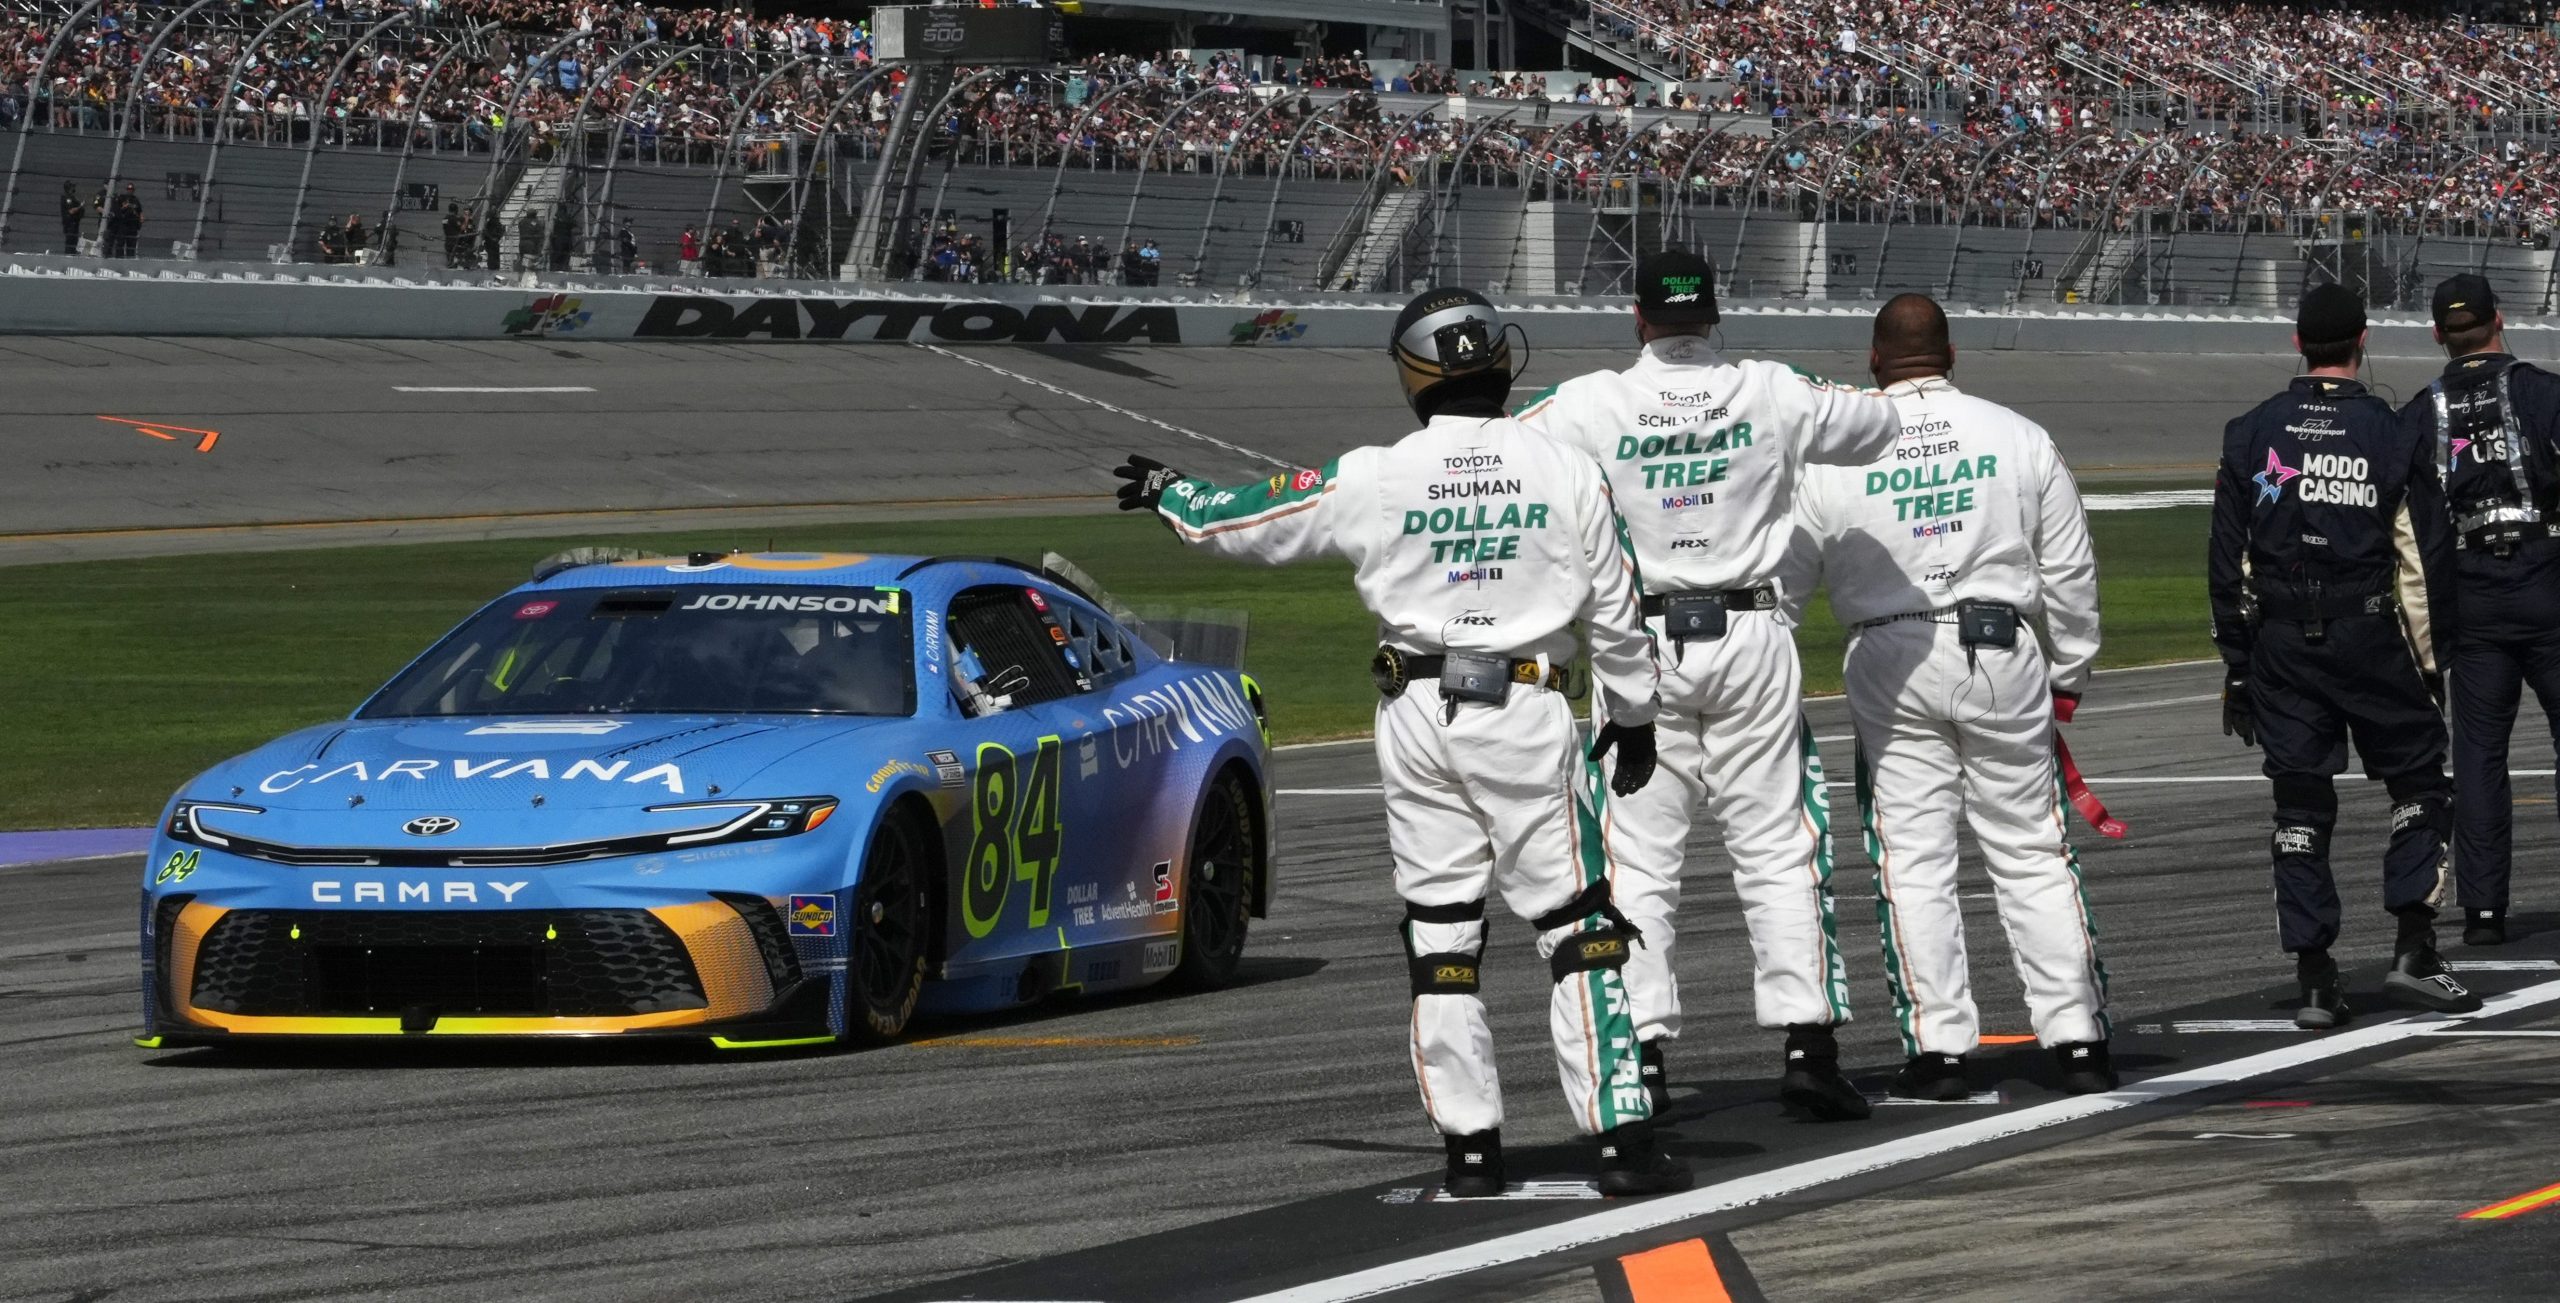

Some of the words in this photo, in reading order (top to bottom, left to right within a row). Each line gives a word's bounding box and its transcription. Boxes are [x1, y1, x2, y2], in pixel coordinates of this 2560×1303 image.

[923, 28, 964, 42] 500
[1662, 277, 1701, 285] DOLLAR
[1670, 285, 1695, 293] TREE
[1423, 297, 1469, 313] LEGACY
[634, 296, 1181, 344] DAYTONA
[1900, 420, 1952, 436] TOYOTA
[1616, 422, 1752, 460] DOLLAR
[1896, 440, 1959, 460] ROZIER
[1443, 454, 1503, 469] TOYOTA
[2302, 453, 2368, 481] MODO
[1641, 458, 1730, 489] TREE
[1866, 455, 1997, 496] DOLLAR
[1428, 479, 1521, 500] SHUMAN
[2299, 478, 2378, 508] CASINO
[1662, 494, 1699, 509] Mobil
[1701, 493, 1713, 505] 1
[1893, 487, 1974, 521] TREE
[1403, 503, 1549, 536] DOLLAR
[1913, 523, 1948, 538] Mobil
[1951, 520, 1963, 532] 1
[1430, 535, 1520, 564] TREE
[1448, 569, 1487, 583] Mobil
[1490, 568, 1502, 580] 1
[681, 594, 888, 614] JOHNSON
[925, 609, 939, 661] CARVANA
[1103, 671, 1253, 769] CARVANA
[259, 758, 684, 794] CARVANA
[962, 734, 1062, 939] 84
[156, 849, 201, 885] 84
[312, 882, 529, 903] CAMRY
[1067, 882, 1098, 905] DOLLAR
[792, 910, 832, 922] SUNOCO
[1073, 906, 1095, 926] TREE
[1101, 899, 1152, 921] AdventHealth
[1145, 945, 1167, 969] Mobil
[1465, 1153, 1482, 1164] OMP
